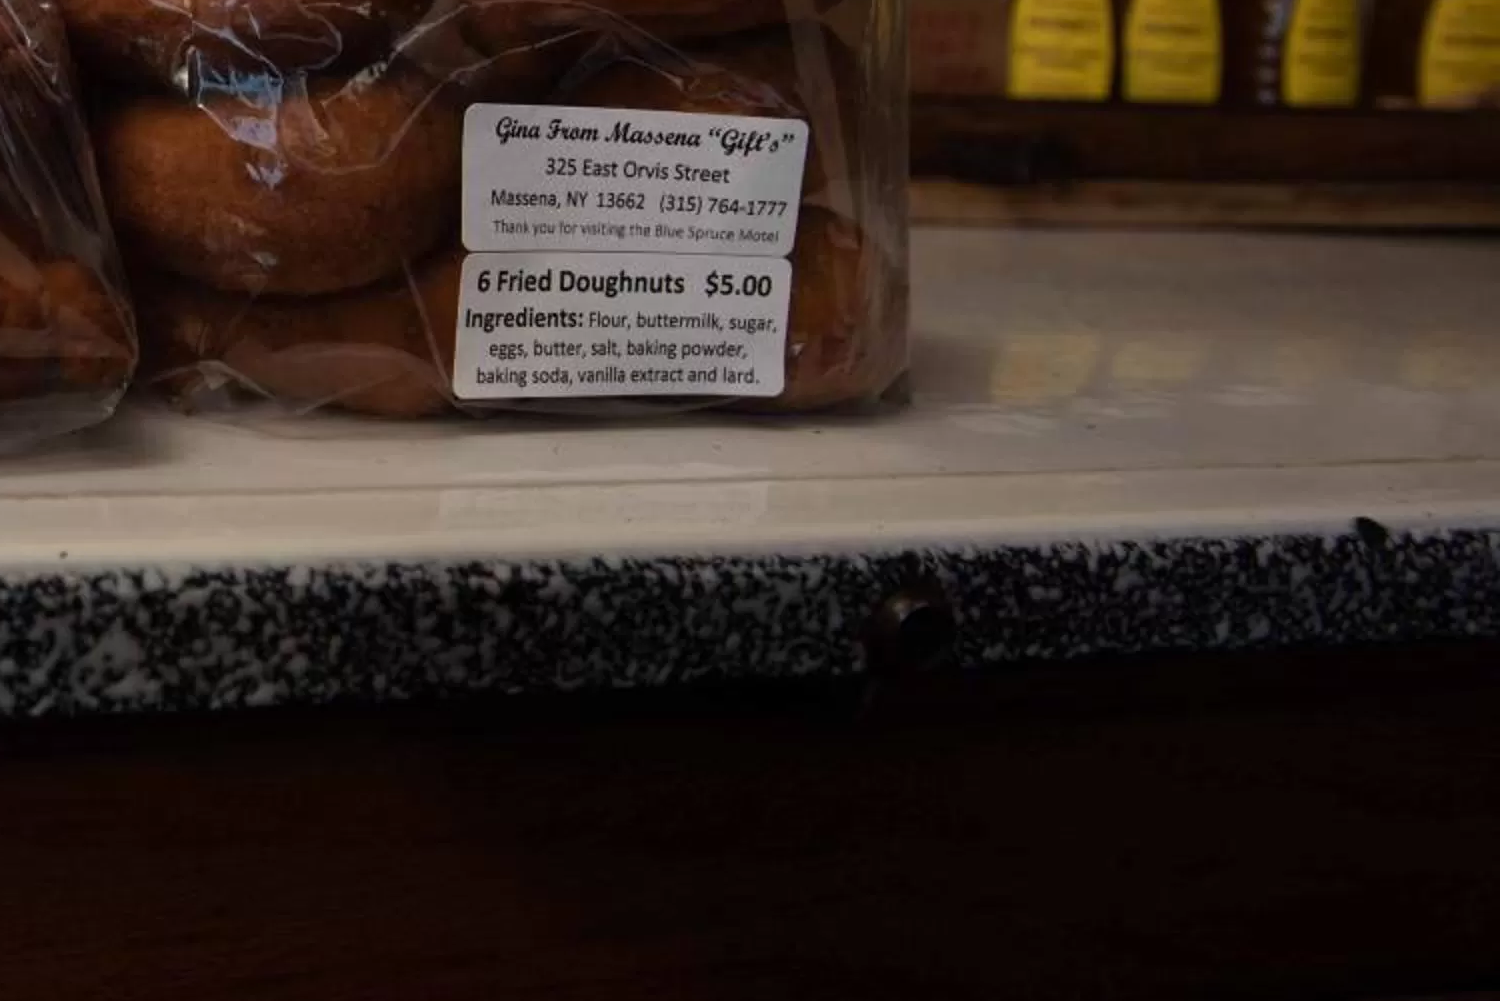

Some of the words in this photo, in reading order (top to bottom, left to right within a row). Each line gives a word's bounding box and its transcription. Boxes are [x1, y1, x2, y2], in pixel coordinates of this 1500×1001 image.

[496, 116, 540, 144] Gina
[546, 119, 599, 141] From
[604, 122, 701, 147] Massena
[546, 157, 577, 176] 325
[582, 159, 618, 178] East
[623, 161, 669, 180] Orvis
[673, 164, 730, 183] Street
[491, 189, 561, 209] Massena,
[567, 191, 588, 207] NY
[597, 192, 645, 210] 13662
[660, 194, 702, 215] (315)
[708, 197, 787, 216] 764-1777
[492, 219, 530, 234] Thank
[532, 223, 555, 237] you
[558, 221, 578, 235] for
[580, 221, 626, 239] visiting
[629, 223, 651, 237] the
[655, 223, 684, 239] Blue
[688, 226, 735, 242] Spruce
[738, 229, 778, 243] Motel
[478, 270, 490, 293] 6
[497, 269, 552, 292] Fried
[560, 270, 684, 298] Doughnuts
[705, 270, 772, 297] $5.00
[466, 307, 583, 333] Ingredients:
[589, 311, 631, 330] Flour,
[636, 311, 724, 331] buttermilk,
[729, 318, 776, 335] sugar,
[489, 343, 528, 361] eggs,
[534, 339, 586, 359] butter,
[591, 339, 622, 358] salt,
[627, 339, 677, 359] baking
[681, 341, 747, 359] powder,
[476, 367, 527, 387] baking
[532, 367, 572, 385] soda,
[577, 366, 626, 383] vanilla
[630, 367, 684, 382] extract
[687, 367, 717, 382] and
[723, 367, 759, 384] lard.
